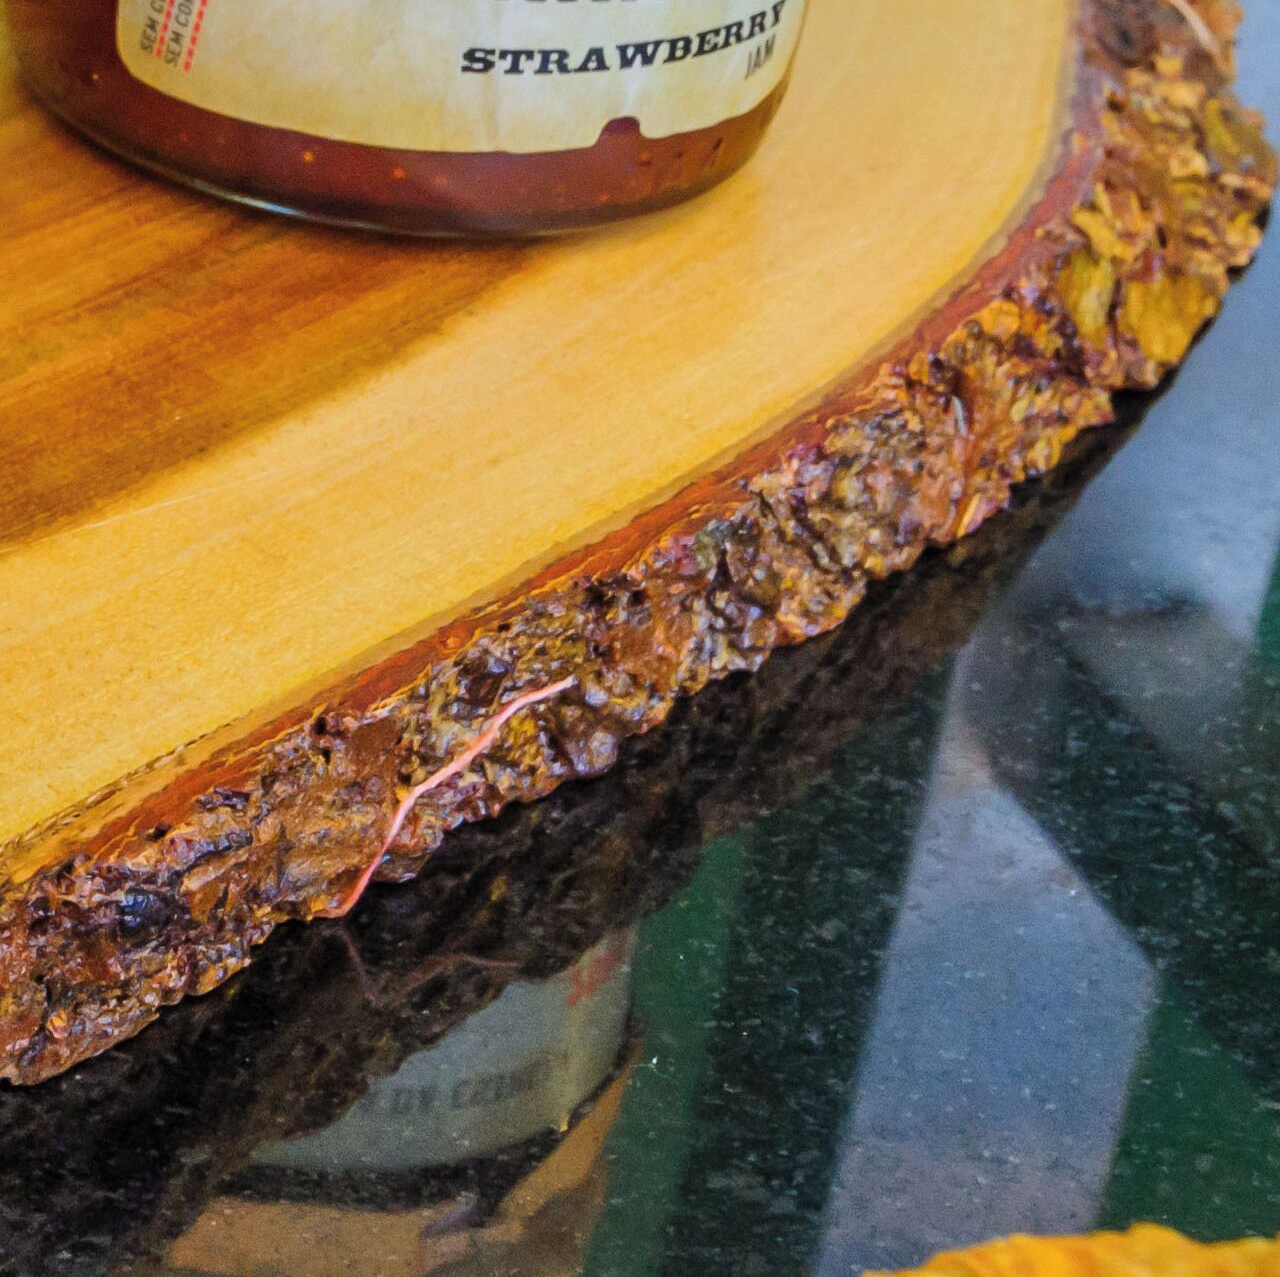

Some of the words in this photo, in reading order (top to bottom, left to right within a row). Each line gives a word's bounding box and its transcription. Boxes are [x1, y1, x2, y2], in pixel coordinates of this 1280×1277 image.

[140, 15, 157, 54] SEM
[163, 29, 186, 68] SEM
[743, 34, 778, 81] JAM
